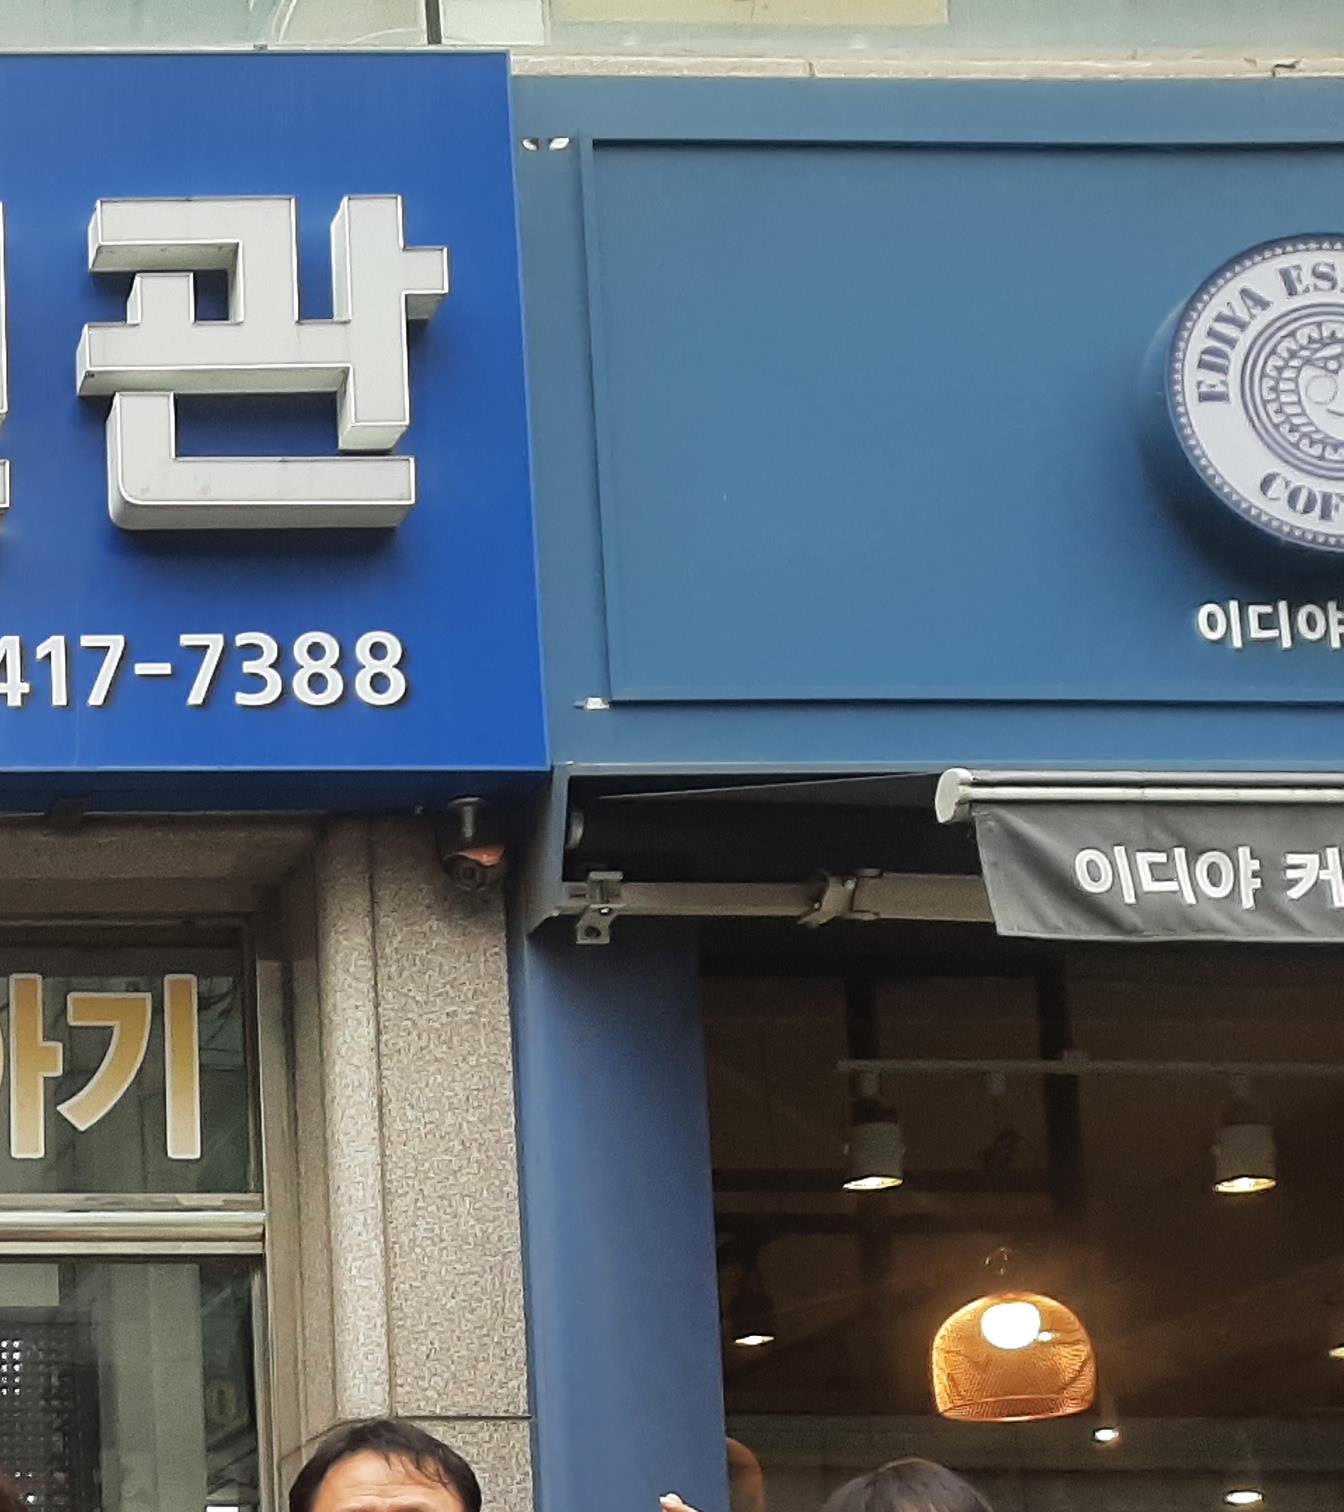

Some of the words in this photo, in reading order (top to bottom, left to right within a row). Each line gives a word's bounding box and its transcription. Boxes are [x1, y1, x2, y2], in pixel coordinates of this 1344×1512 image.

[1197, 286, 1273, 404] EDIYA
[1278, 260, 1344, 298] ES
[1196, 599, 1344, 650] 이디야
[1074, 844, 1263, 911] 이디야
[1284, 844, 1344, 909] 커
